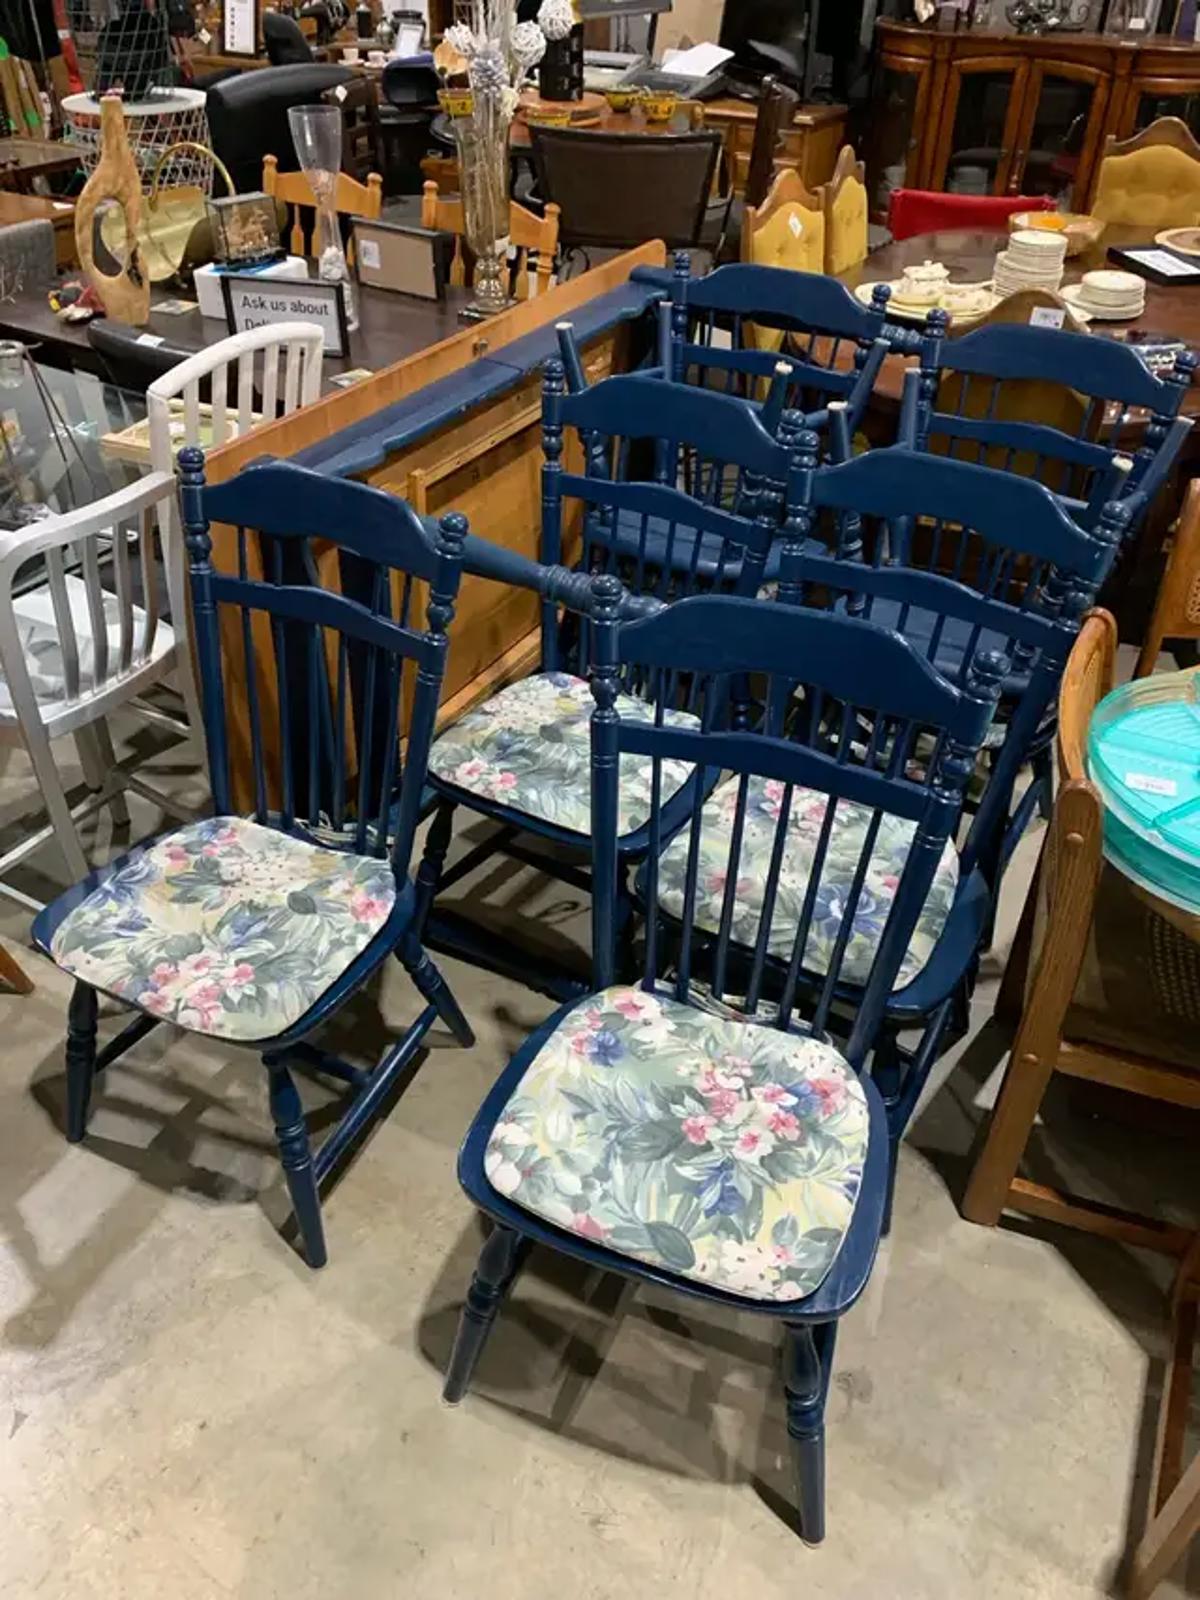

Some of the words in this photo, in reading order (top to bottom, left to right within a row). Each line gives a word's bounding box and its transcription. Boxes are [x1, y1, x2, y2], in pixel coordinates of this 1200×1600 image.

[242, 296, 267, 310] Ask
[270, 301, 287, 311] us
[290, 300, 328, 315] about
